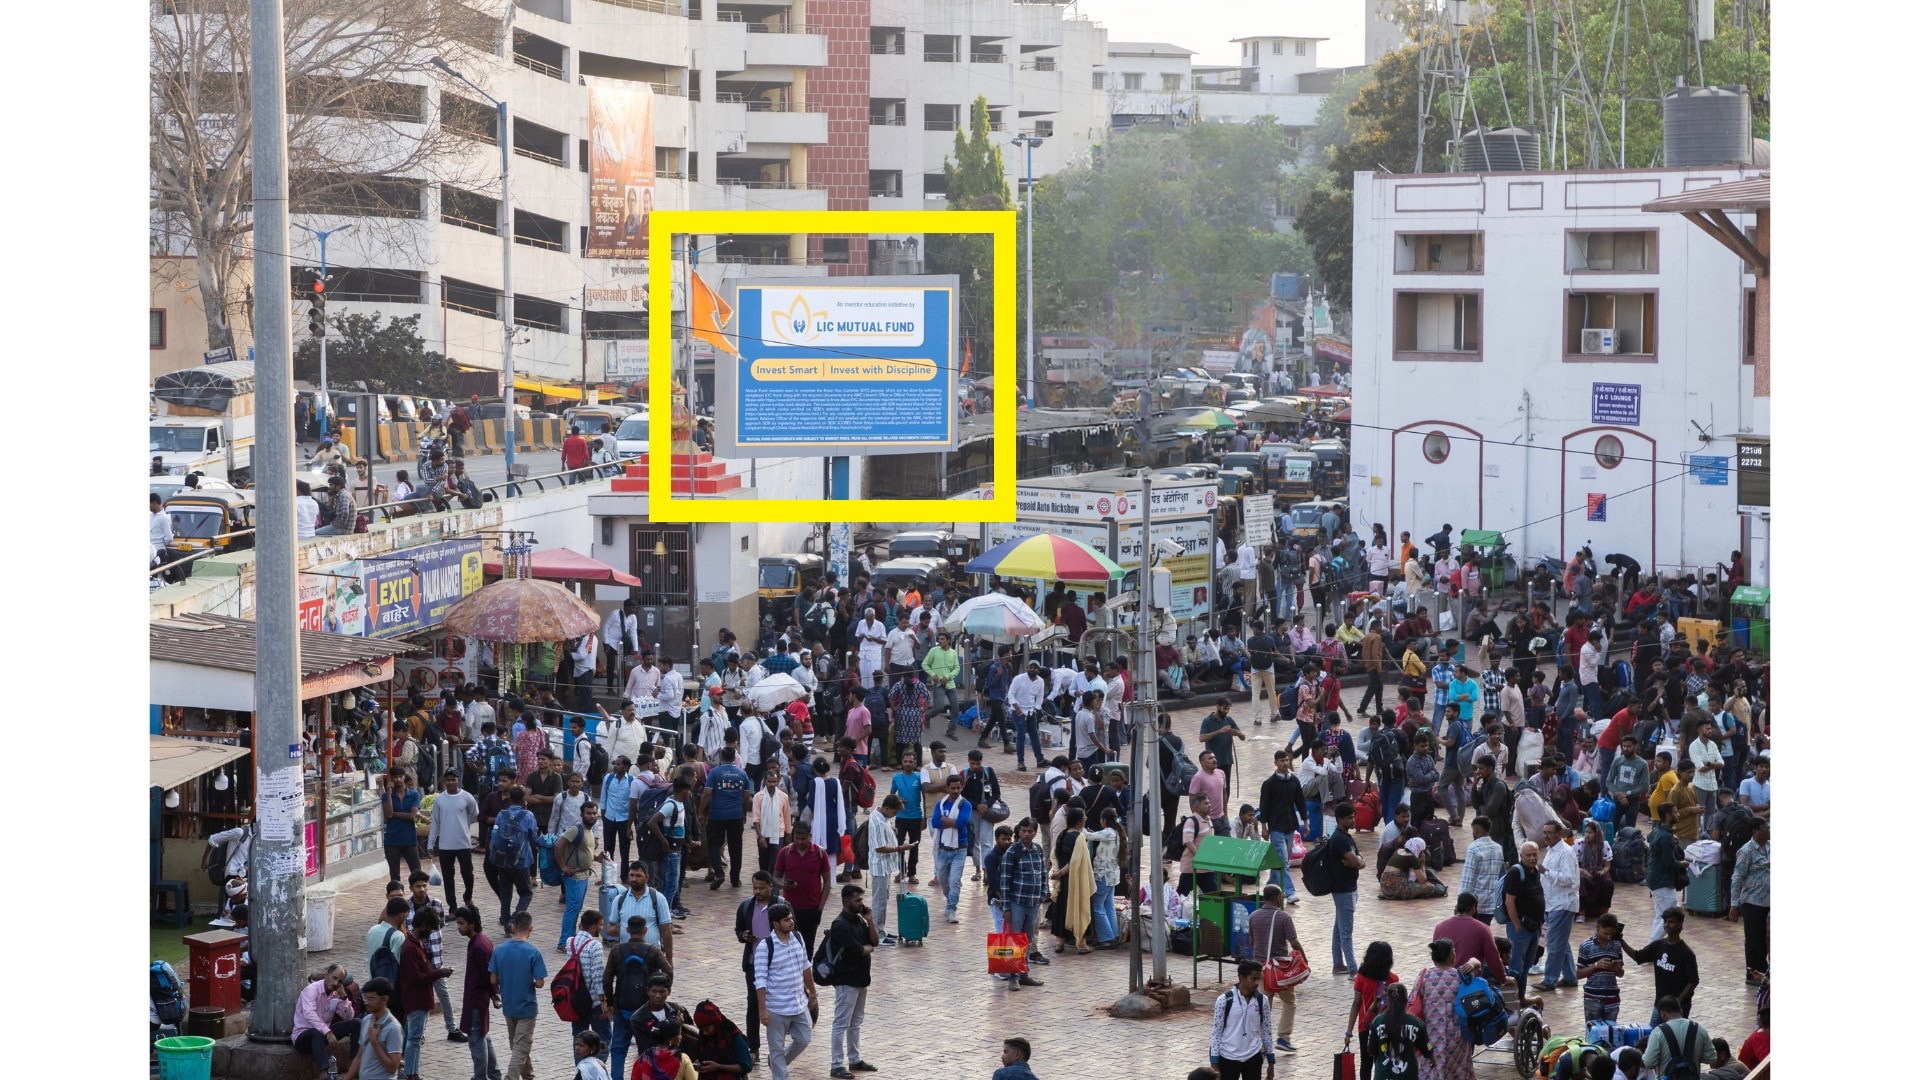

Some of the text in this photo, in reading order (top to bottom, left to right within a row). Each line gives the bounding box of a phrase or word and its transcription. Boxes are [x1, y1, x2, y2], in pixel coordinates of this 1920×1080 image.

[816, 321, 915, 332] LIC MUTUAL FUND
[756, 365, 818, 374] Invest Smart
[830, 365, 932, 377] Invest with Discipline
[1741, 458, 1762, 467] 22732
[1036, 502, 1050, 513] Auto
[1051, 502, 1080, 514] Rickshaw
[380, 576, 412, 607] EXIT
[382, 604, 410, 623] बाहेर
